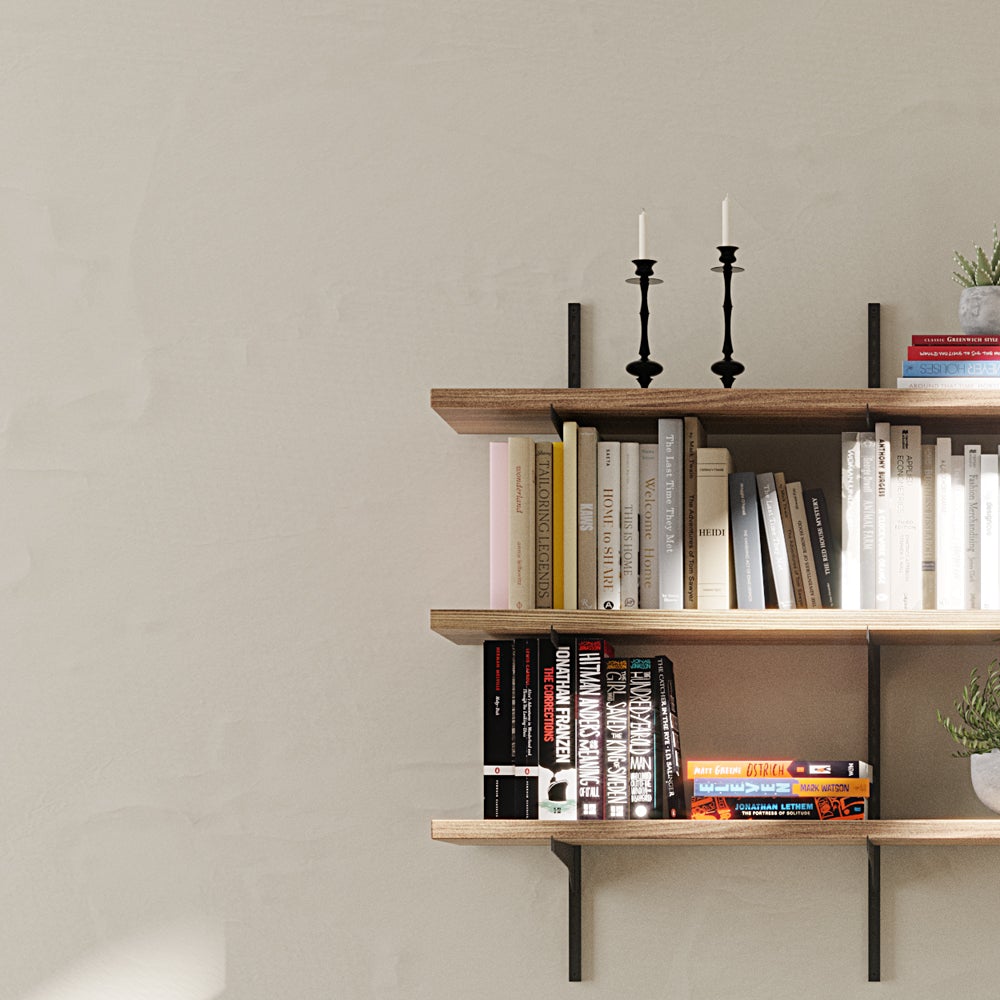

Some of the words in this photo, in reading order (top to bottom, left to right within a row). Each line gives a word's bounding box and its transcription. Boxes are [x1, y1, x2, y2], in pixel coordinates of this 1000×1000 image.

[920, 363, 965, 374] HOUSES
[665, 435, 674, 453] The
[665, 456, 674, 477] Last
[861, 457, 873, 476] George
[515, 466, 523, 513] wonderland
[538, 460, 550, 533] TAILORING
[665, 480, 674, 504] Time
[863, 476, 874, 493] Orwell
[969, 474, 977, 501] Fashion
[580, 503, 593, 531] KAWS
[603, 488, 613, 527] HOME
[624, 504, 633, 530] THIS
[644, 477, 655, 540] Welcome
[663, 507, 674, 531] They
[766, 500, 774, 517] Last
[812, 497, 823, 527] MYSTERY
[863, 500, 874, 528] ANIMAL
[603, 532, 613, 543] to
[624, 532, 633, 541] IS
[817, 527, 827, 548] HOUSE
[863, 530, 874, 550] FARM
[967, 502, 978, 553] Merchandising
[665, 534, 674, 553] Met
[689, 550, 695, 558] of
[820, 549, 828, 562] RED
[538, 537, 550, 599] LEGENDS
[603, 547, 613, 592] SHARE
[623, 544, 633, 576] HOME
[644, 548, 655, 589] Home
[805, 562, 816, 596] ADVENTURES
[543, 667, 554, 683] THE
[579, 653, 601, 695] HITMAN
[606, 672, 626, 699] GIRL
[543, 684, 554, 742] CORRECTIONS
[578, 698, 601, 737] ANDERS
[606, 701, 627, 733] SAVED
[662, 707, 668, 715] IN
[556, 708, 571, 763] FRANZEN
[578, 740, 600, 786] MEANING
[606, 740, 627, 762] KING
[630, 757, 651, 770] MAN
[694, 766, 712, 775] MATT
[715, 765, 742, 775] GREENE
[746, 763, 784, 777] OSTRICH
[606, 767, 627, 803] SWEDEN
[699, 782, 791, 793] ELEVEN
[800, 784, 820, 792] MARK
[821, 784, 850, 792] WATSON
